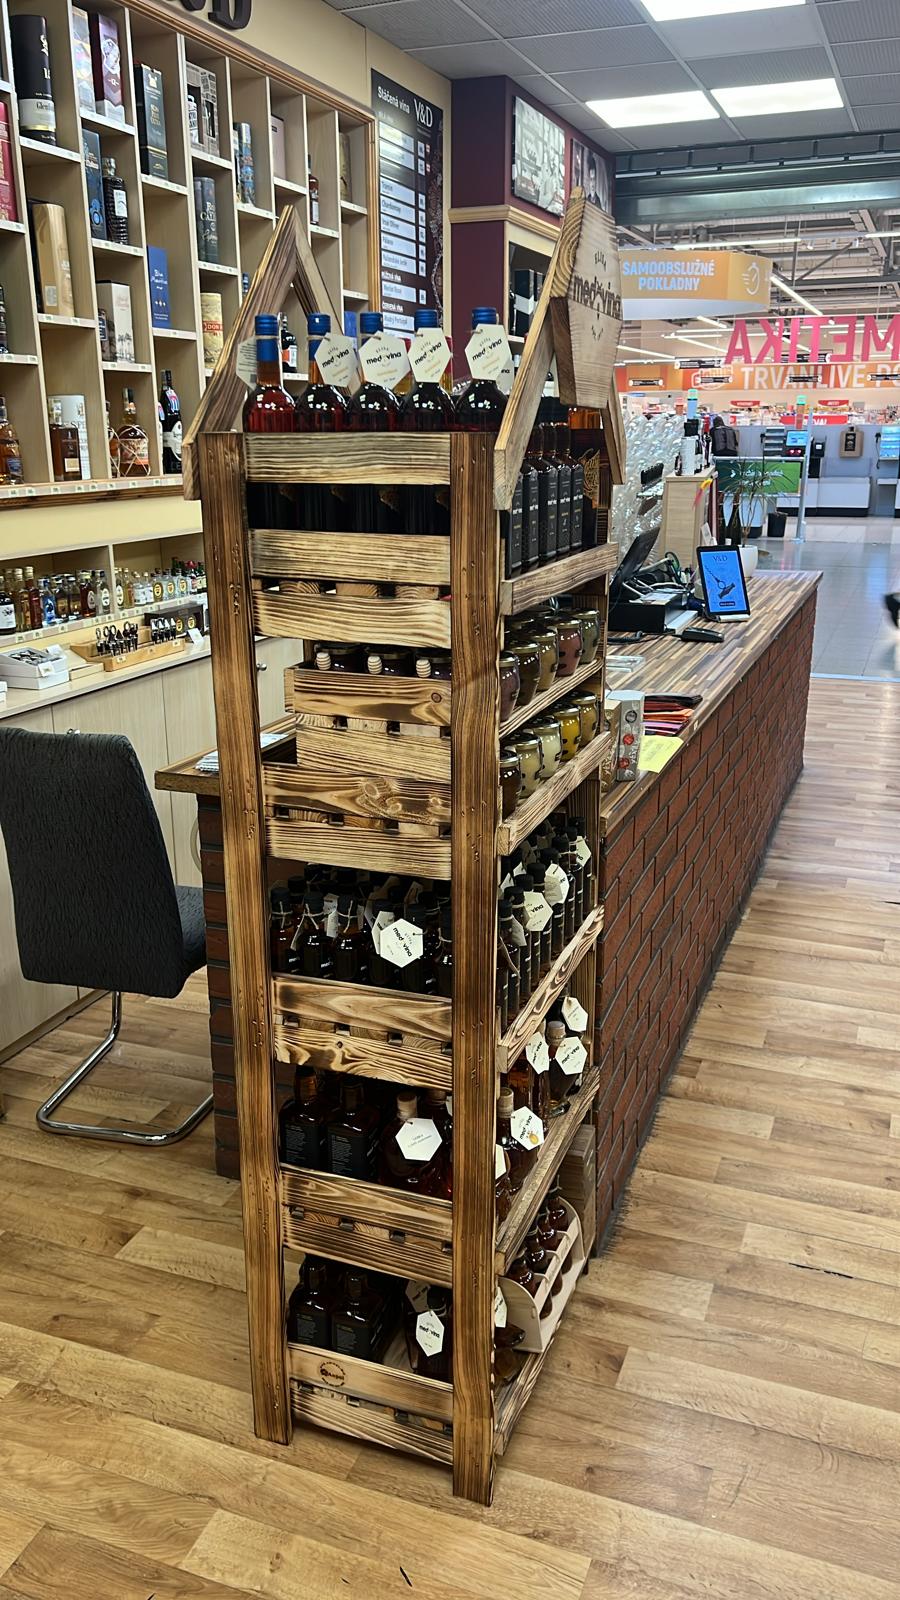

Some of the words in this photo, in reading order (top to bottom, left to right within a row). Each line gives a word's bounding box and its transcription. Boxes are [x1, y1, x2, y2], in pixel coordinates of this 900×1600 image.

[377, 86, 399, 108] Stáčená
[413, 98, 433, 128] V&D
[623, 259, 715, 276] SAMOOBSLUŽNÉ
[638, 277, 700, 291] POKLADNY
